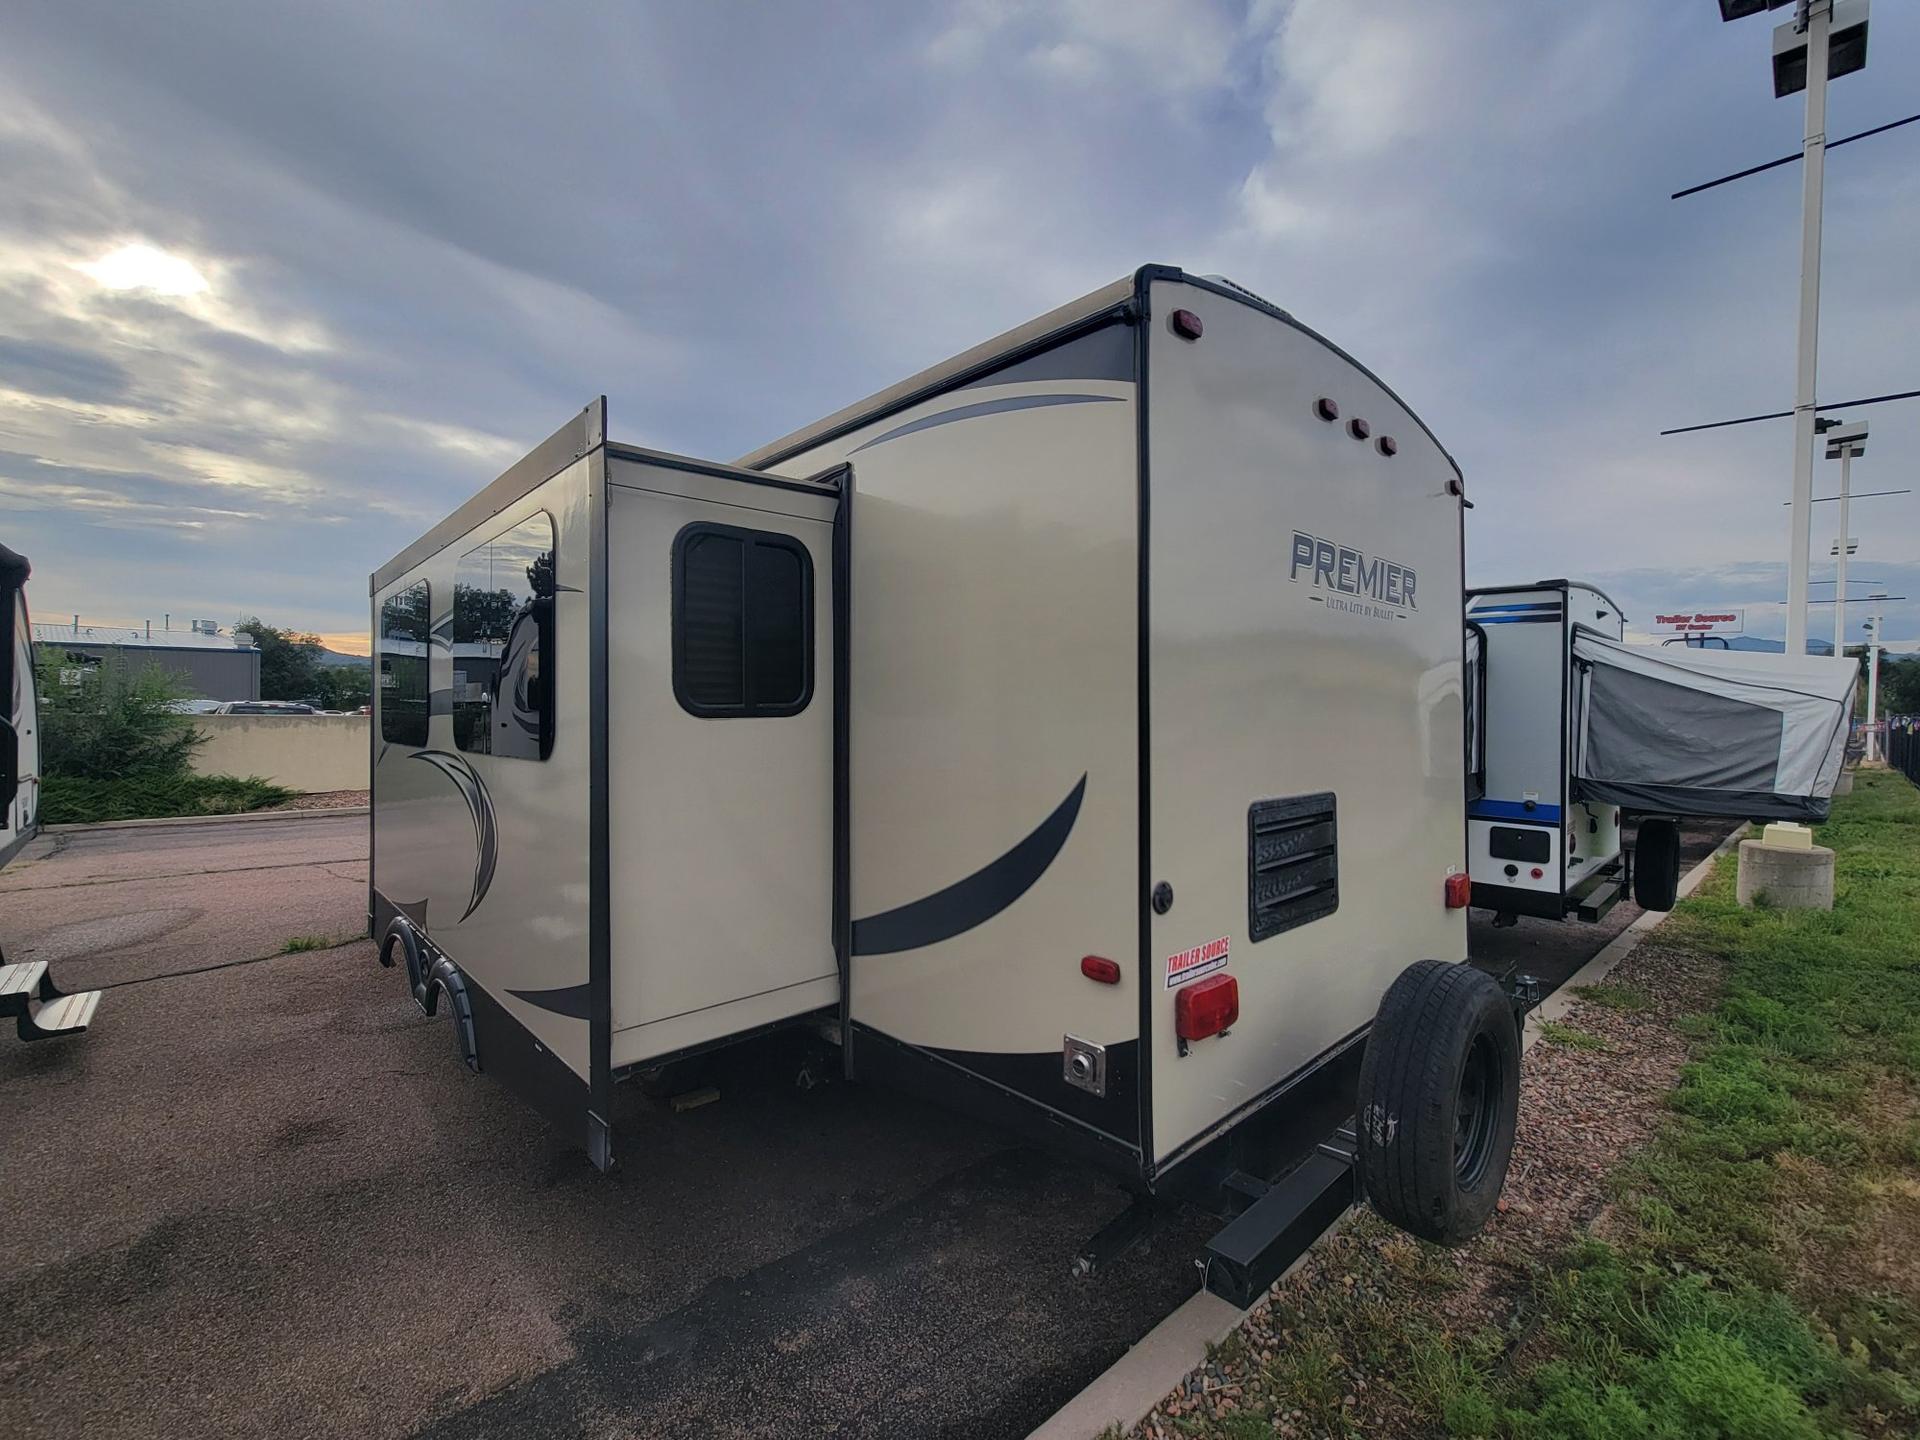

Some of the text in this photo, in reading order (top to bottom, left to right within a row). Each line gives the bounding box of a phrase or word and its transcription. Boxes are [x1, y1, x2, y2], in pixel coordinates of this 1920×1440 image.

[1289, 530, 1418, 612] PREMIER
[1656, 614, 1737, 624] Trailer Source
[1167, 947, 1201, 974] TRAILER
[1201, 936, 1230, 962] SOURCE
